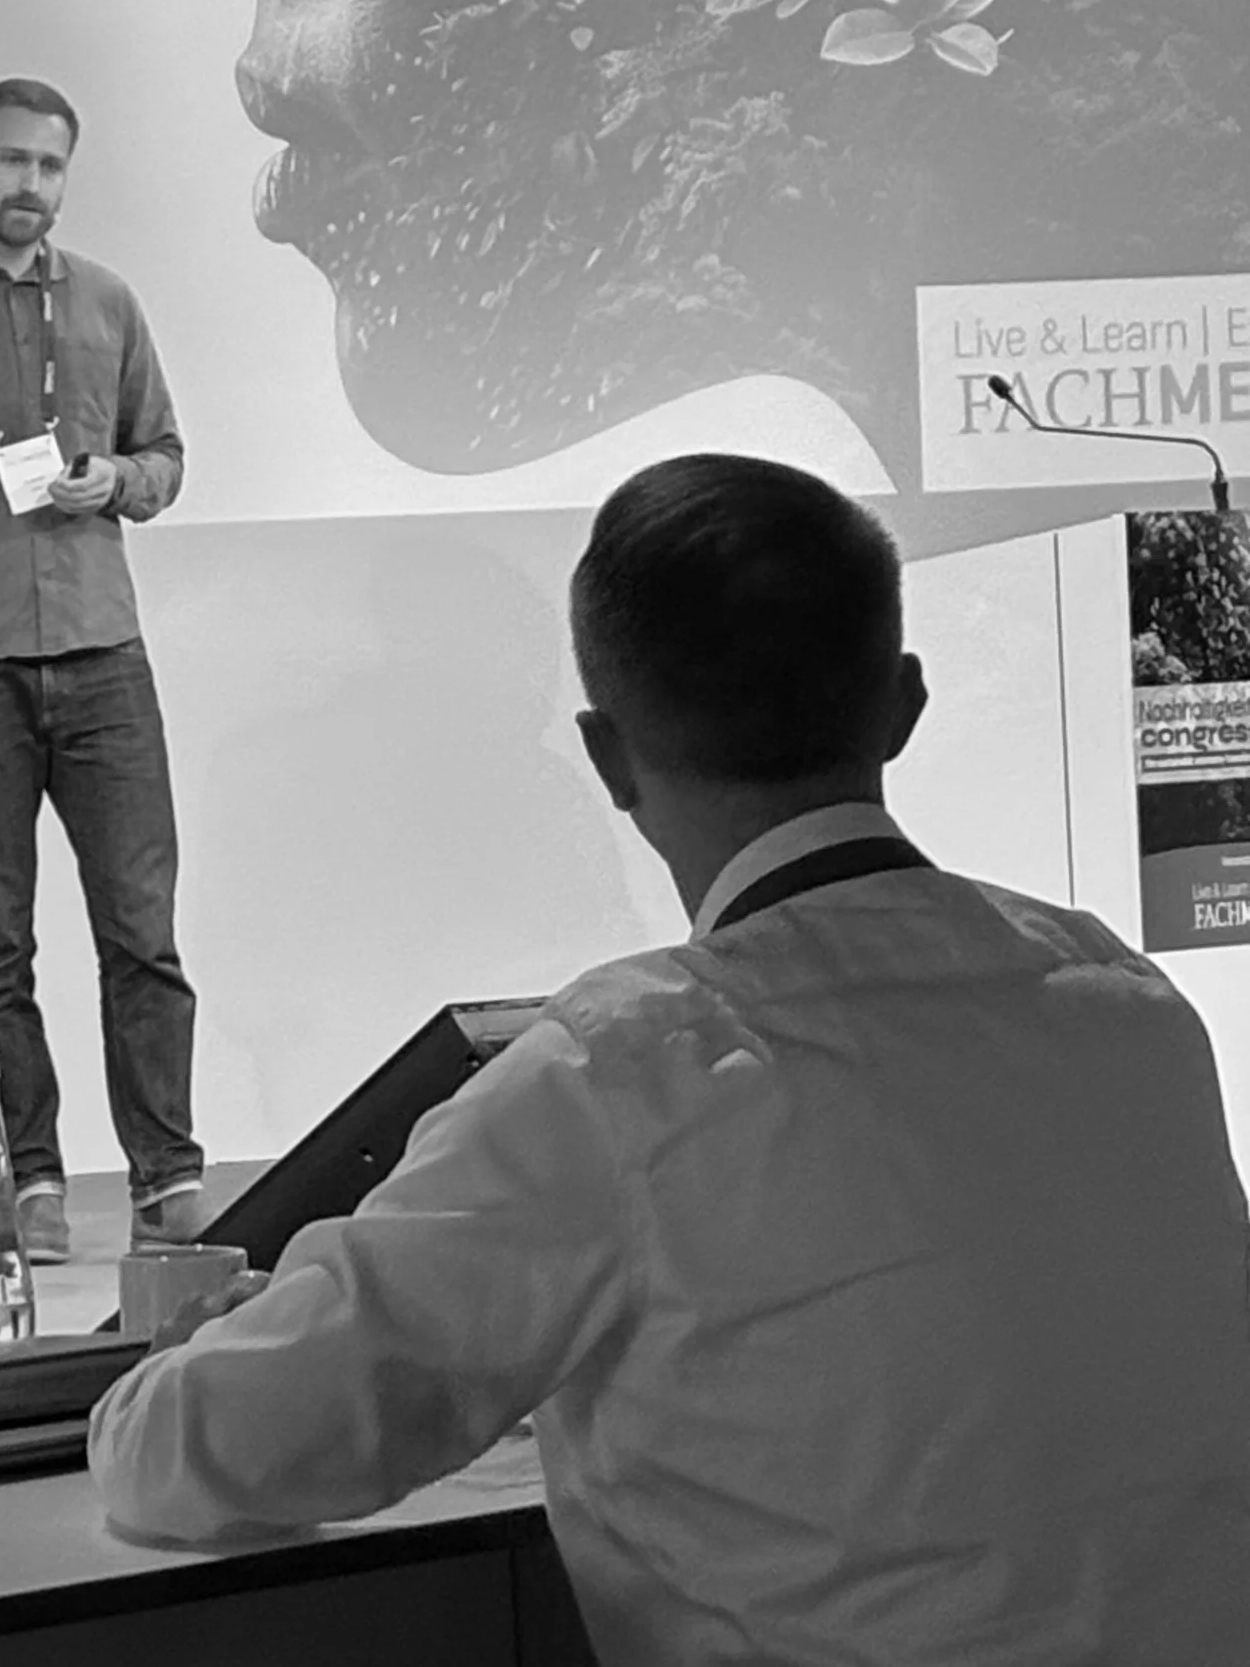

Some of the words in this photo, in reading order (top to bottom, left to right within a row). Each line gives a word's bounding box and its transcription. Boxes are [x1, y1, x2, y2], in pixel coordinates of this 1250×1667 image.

[954, 318, 1027, 359] Live
[1040, 317, 1067, 355] &
[1081, 313, 1188, 354] Learn
[1140, 724, 1250, 752] congres
